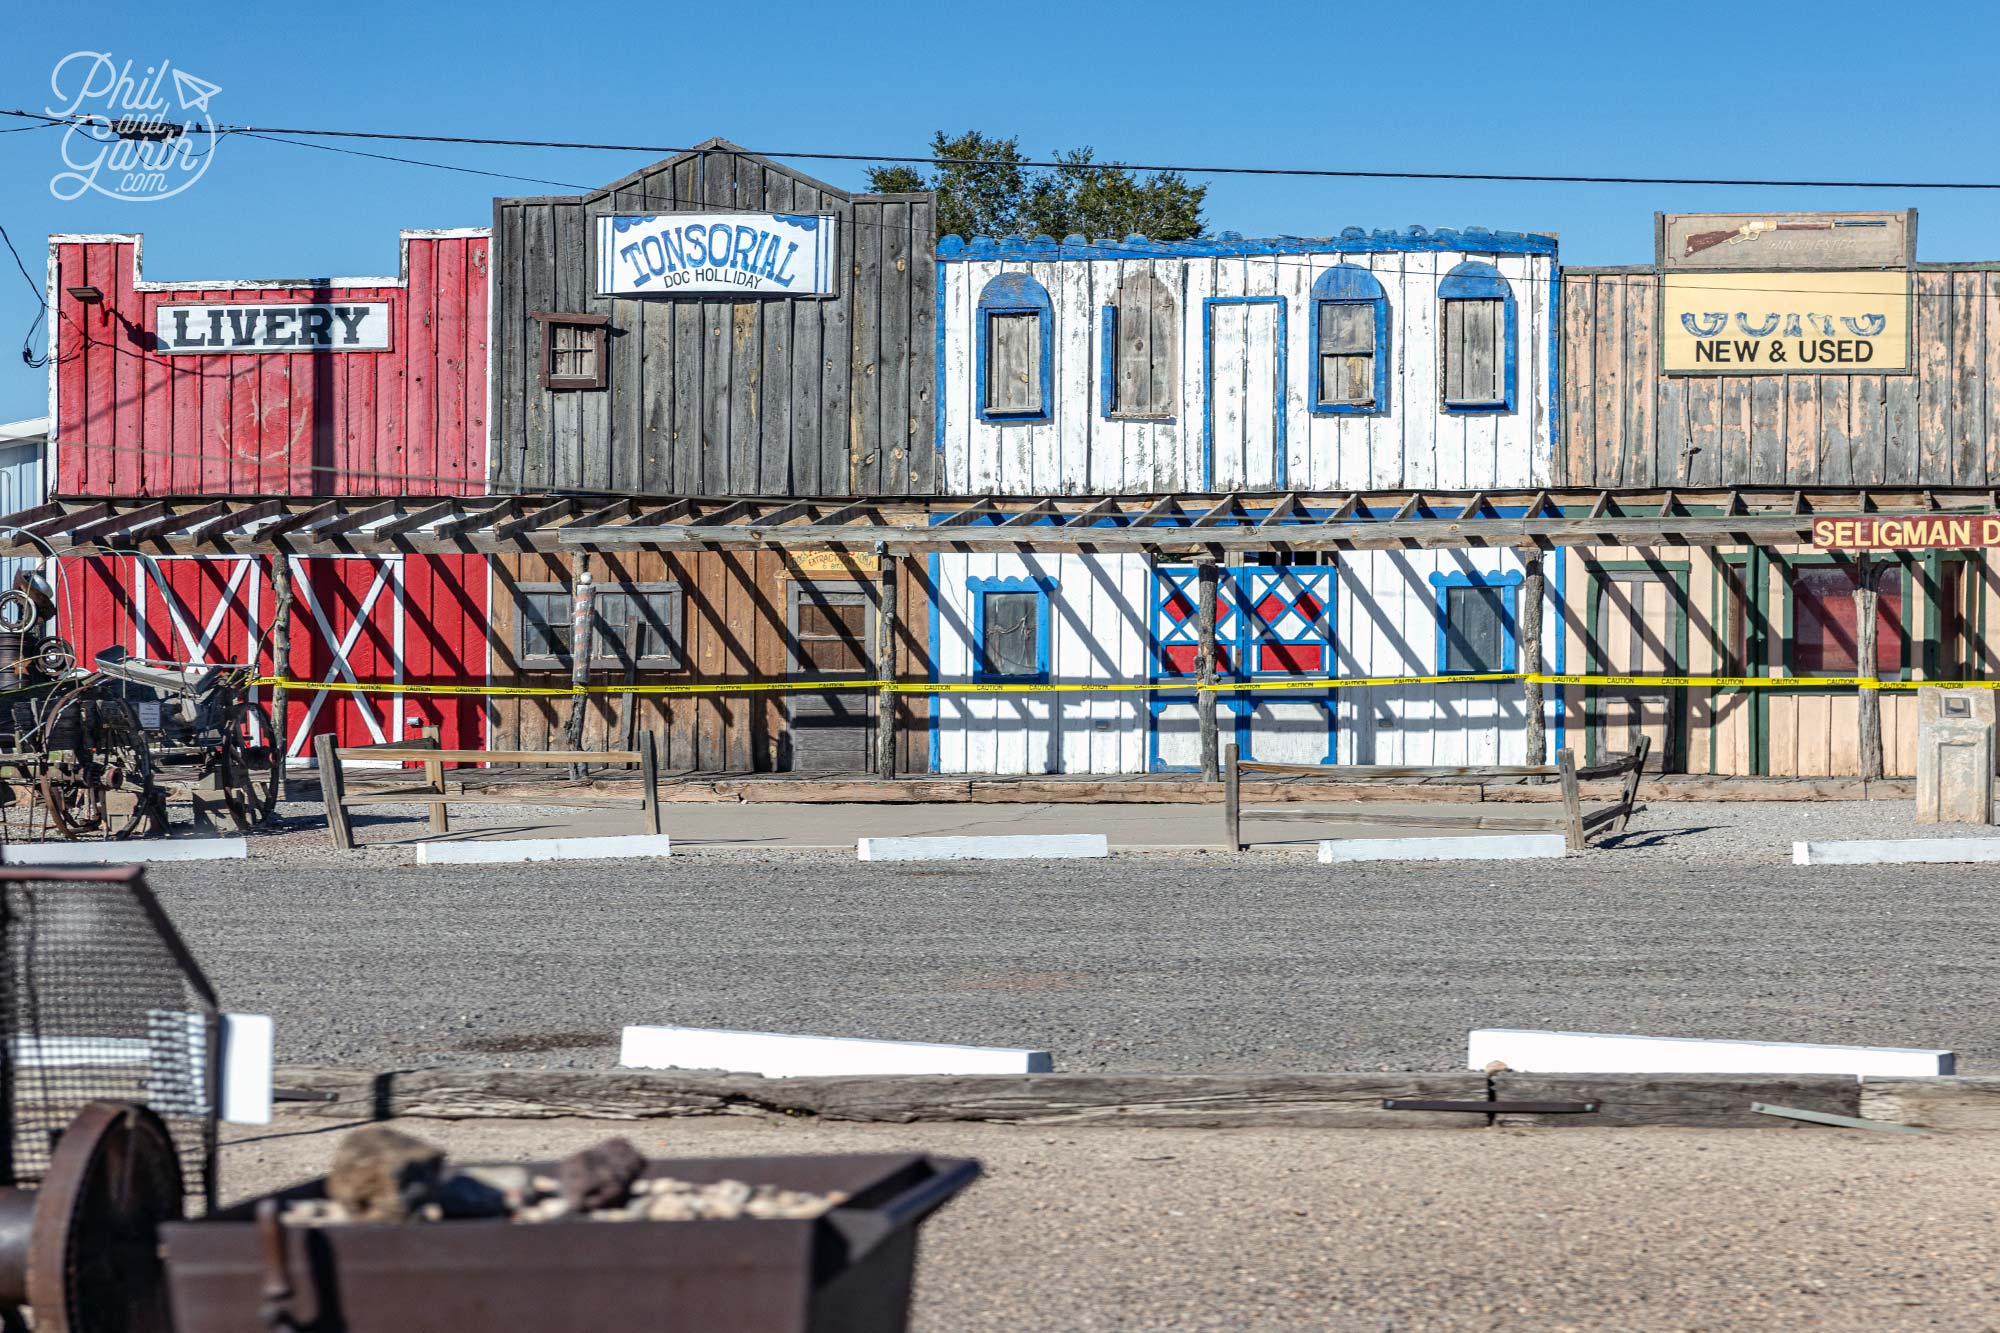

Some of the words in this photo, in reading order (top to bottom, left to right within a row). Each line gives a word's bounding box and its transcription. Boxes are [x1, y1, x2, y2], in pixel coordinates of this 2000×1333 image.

[620, 223, 799, 288] TONSORIAL
[663, 270, 690, 288] DOC
[695, 269, 763, 290] HOLLIDAY
[173, 307, 370, 347] LIVERY
[1695, 340, 1760, 363] NEW
[1769, 340, 1788, 363] &
[1799, 340, 1874, 363] USED
[1815, 520, 1970, 545] SELIGMAN
